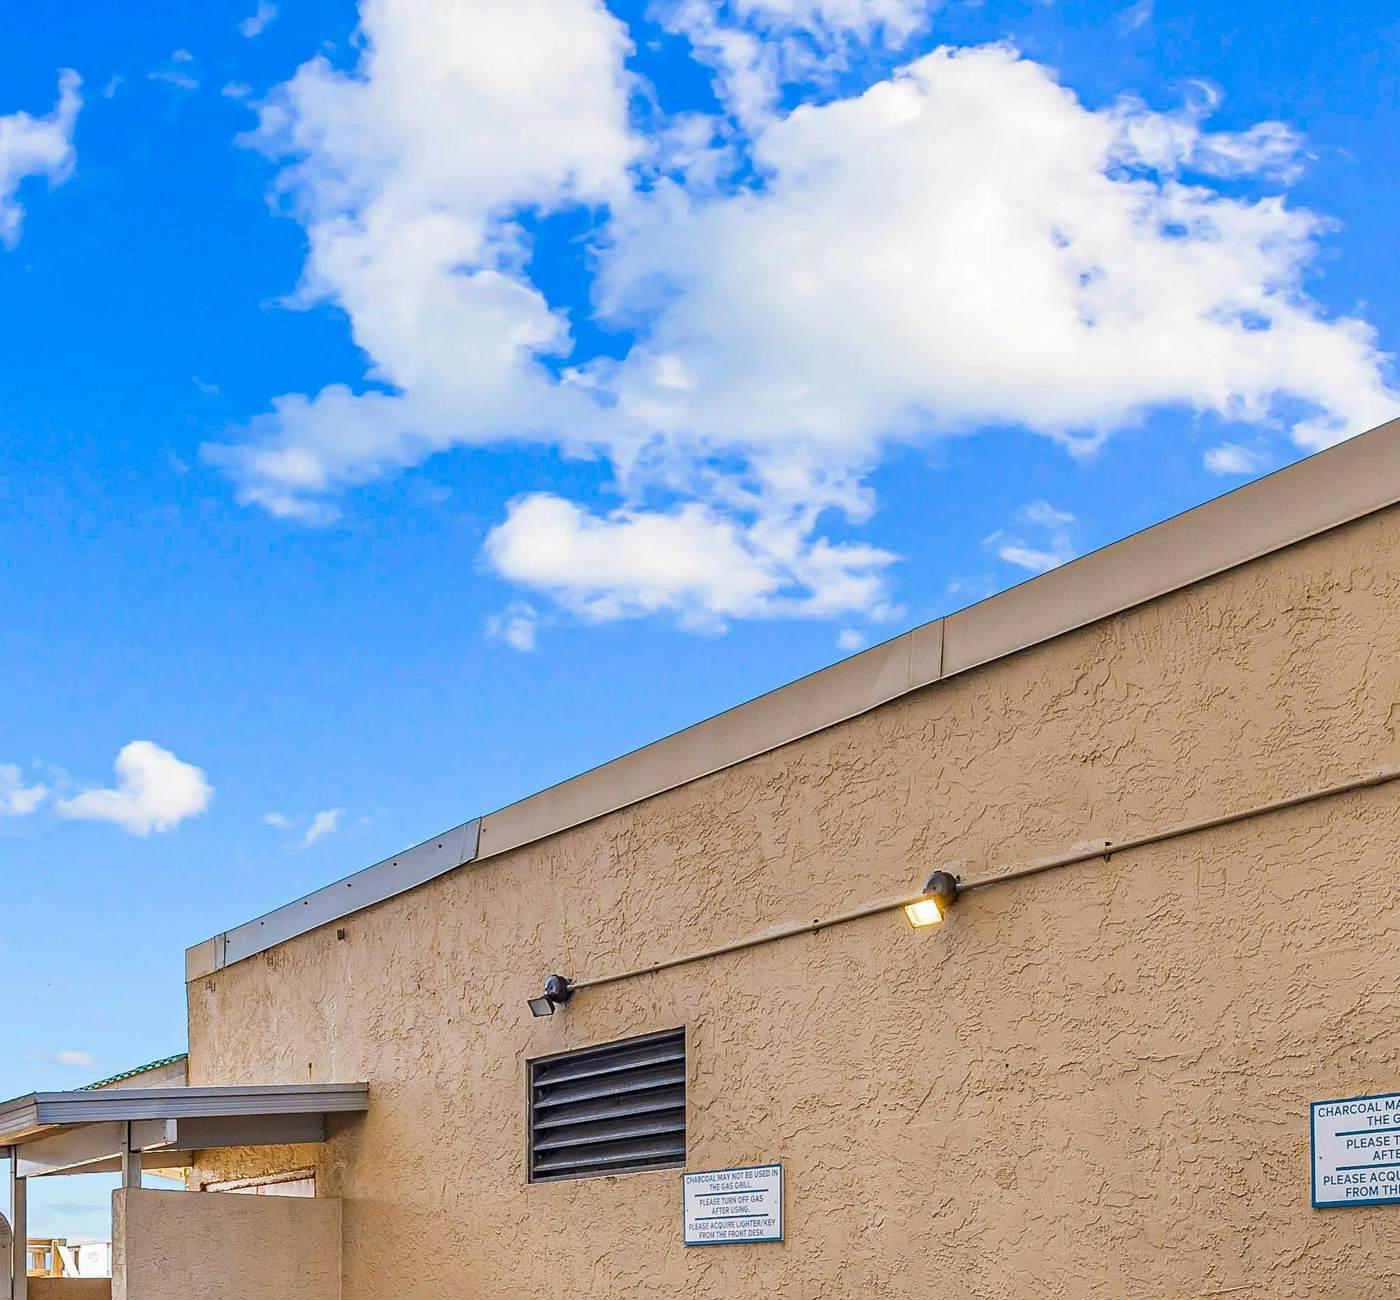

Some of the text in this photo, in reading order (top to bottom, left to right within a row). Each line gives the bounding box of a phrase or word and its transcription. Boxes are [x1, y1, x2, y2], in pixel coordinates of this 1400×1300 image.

[1318, 1100, 1400, 1118] CHARCOAL MA
[1367, 1115, 1390, 1126] THE
[1346, 1136, 1391, 1149] PLEASE
[1373, 1149, 1400, 1161] AFTE
[686, 1176, 716, 1184] CHARCOAL
[718, 1173, 730, 1181] MAY
[732, 1172, 744, 1180] NOT
[754, 1169, 770, 1177] USED
[772, 1169, 778, 1177] IN
[1323, 1171, 1400, 1186] PLEASE ACQU
[709, 1183, 720, 1191] THE
[721, 1182, 734, 1190] GAS
[1346, 1184, 1400, 1198] FROM TH
[699, 1195, 763, 1206] PLEASE TURN OFF GAS
[712, 1207, 730, 1215] AFTER
[689, 1219, 776, 1231] PLEASE ACQUIRE LIGHTER/KEY
[699, 1231, 715, 1239] FROM
[728, 1229, 747, 1237] FRONT
